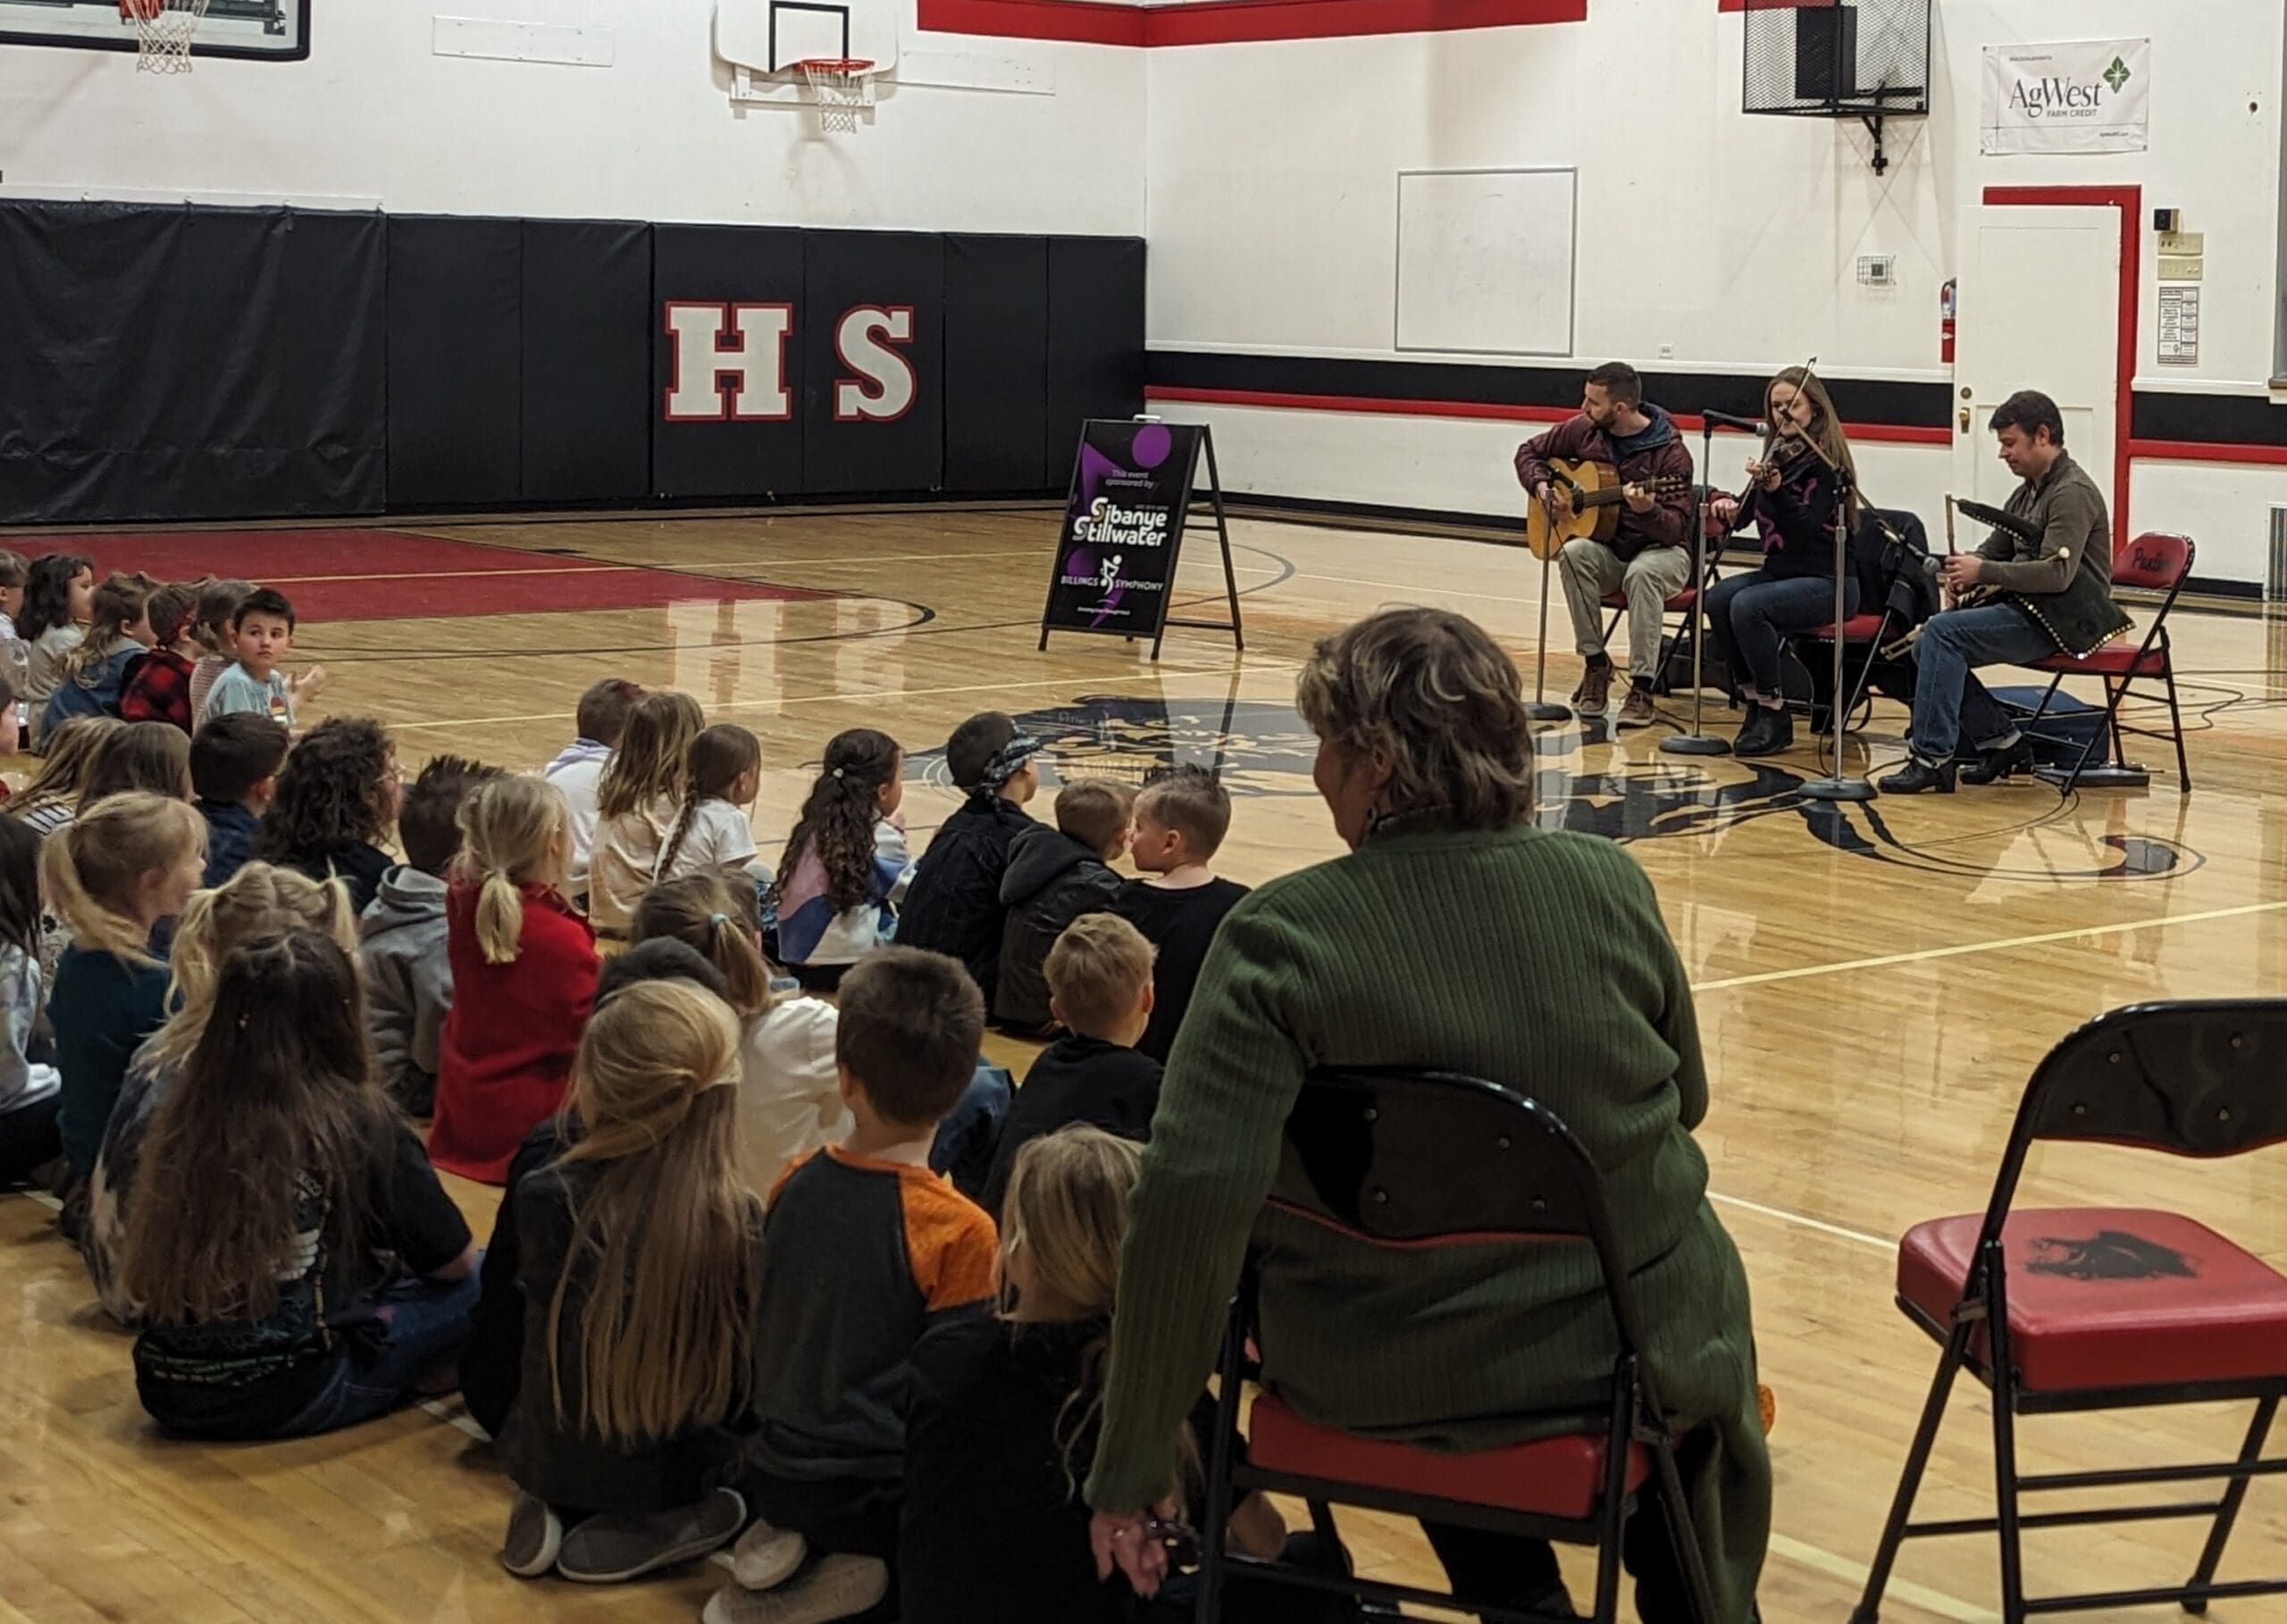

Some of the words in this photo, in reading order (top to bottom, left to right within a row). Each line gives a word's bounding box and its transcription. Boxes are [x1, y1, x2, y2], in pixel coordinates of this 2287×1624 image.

[2008, 77, 2102, 118] AgWest
[2047, 109, 2068, 118] FARM
[2070, 108, 2098, 118] CREDIT
[665, 301, 792, 421] H
[834, 304, 917, 421] S
[1090, 497, 1168, 531] Sibanye
[1072, 515, 1168, 547] Stillwater
[1060, 575, 1099, 587] BILLINGS
[1114, 579, 1164, 591] SYMPHONY
